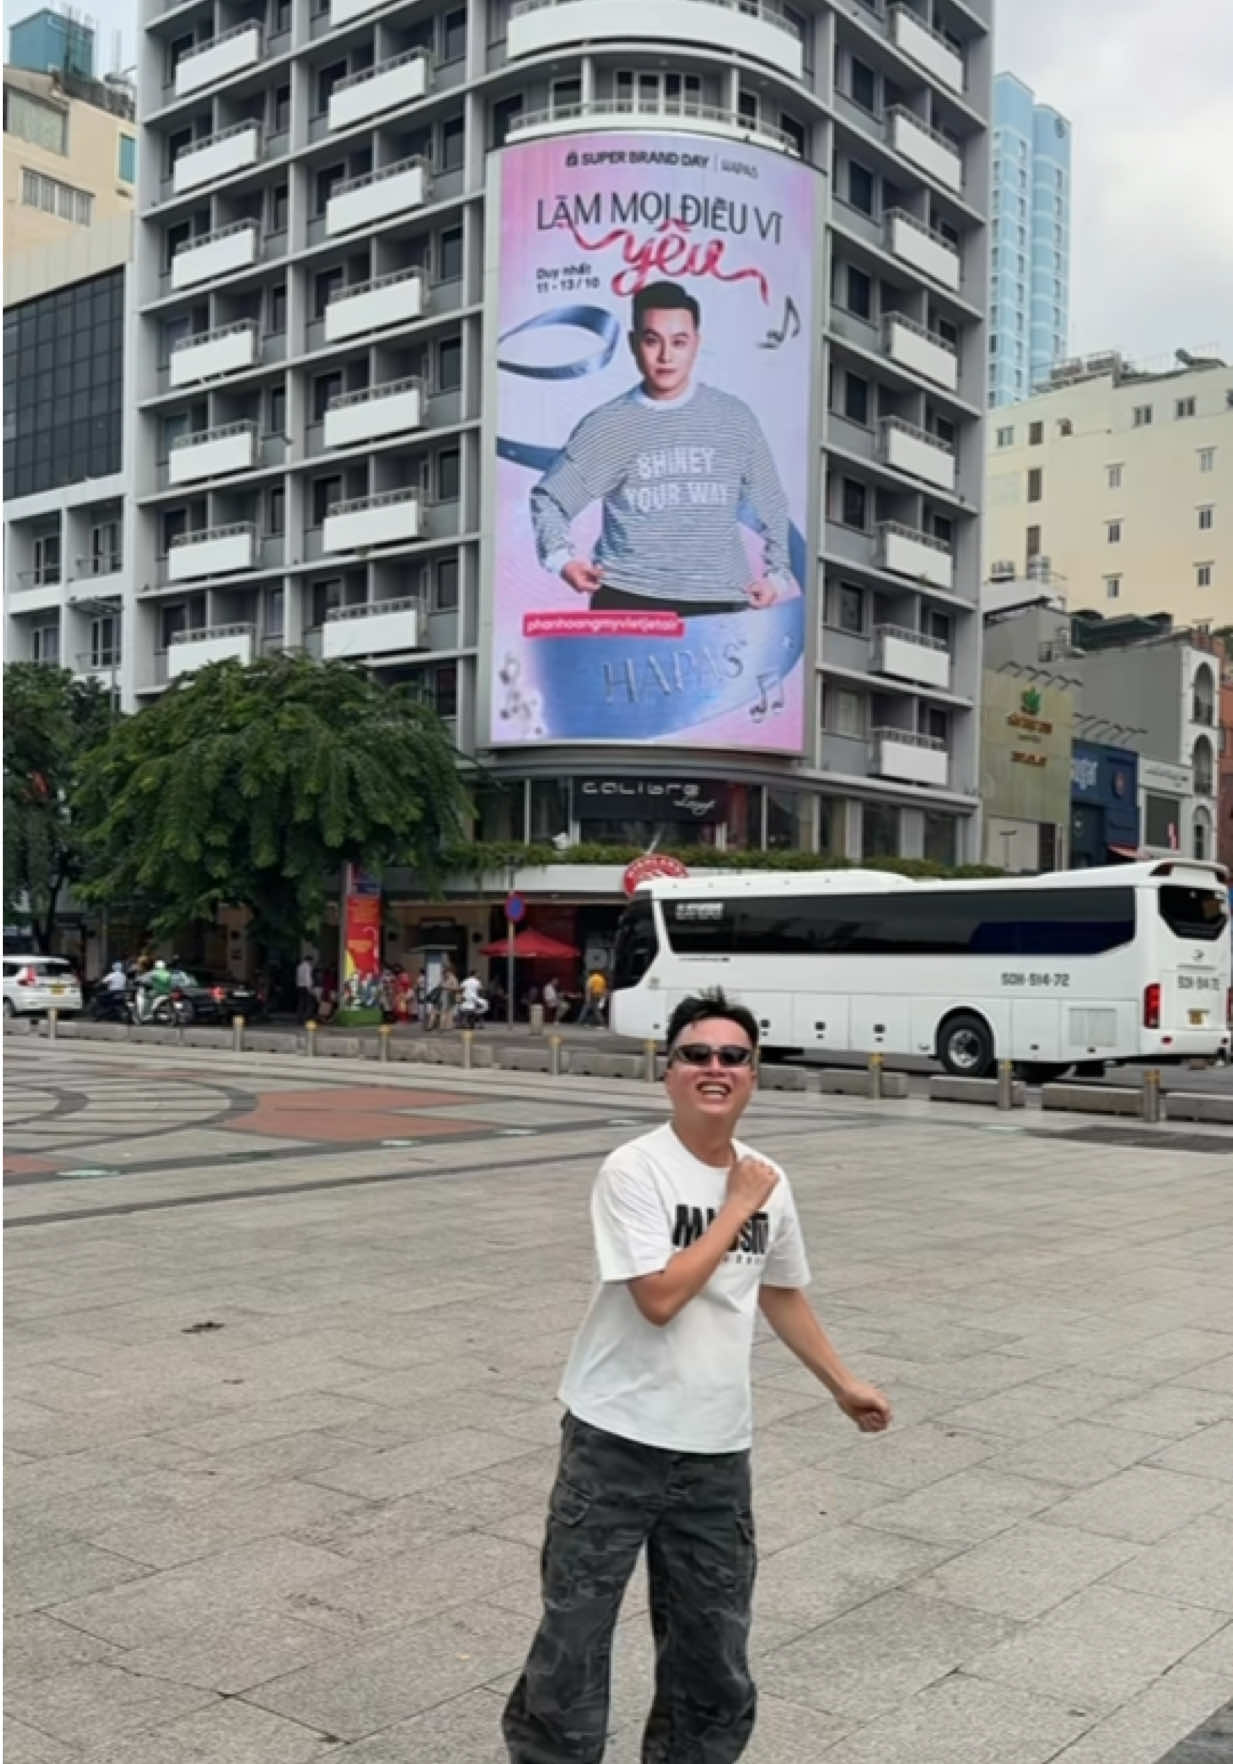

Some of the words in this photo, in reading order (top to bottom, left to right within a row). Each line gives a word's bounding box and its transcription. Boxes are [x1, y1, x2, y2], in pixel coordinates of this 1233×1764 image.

[582, 151, 625, 166] SUPER
[628, 151, 679, 167] BRAND
[681, 153, 709, 168] DAY
